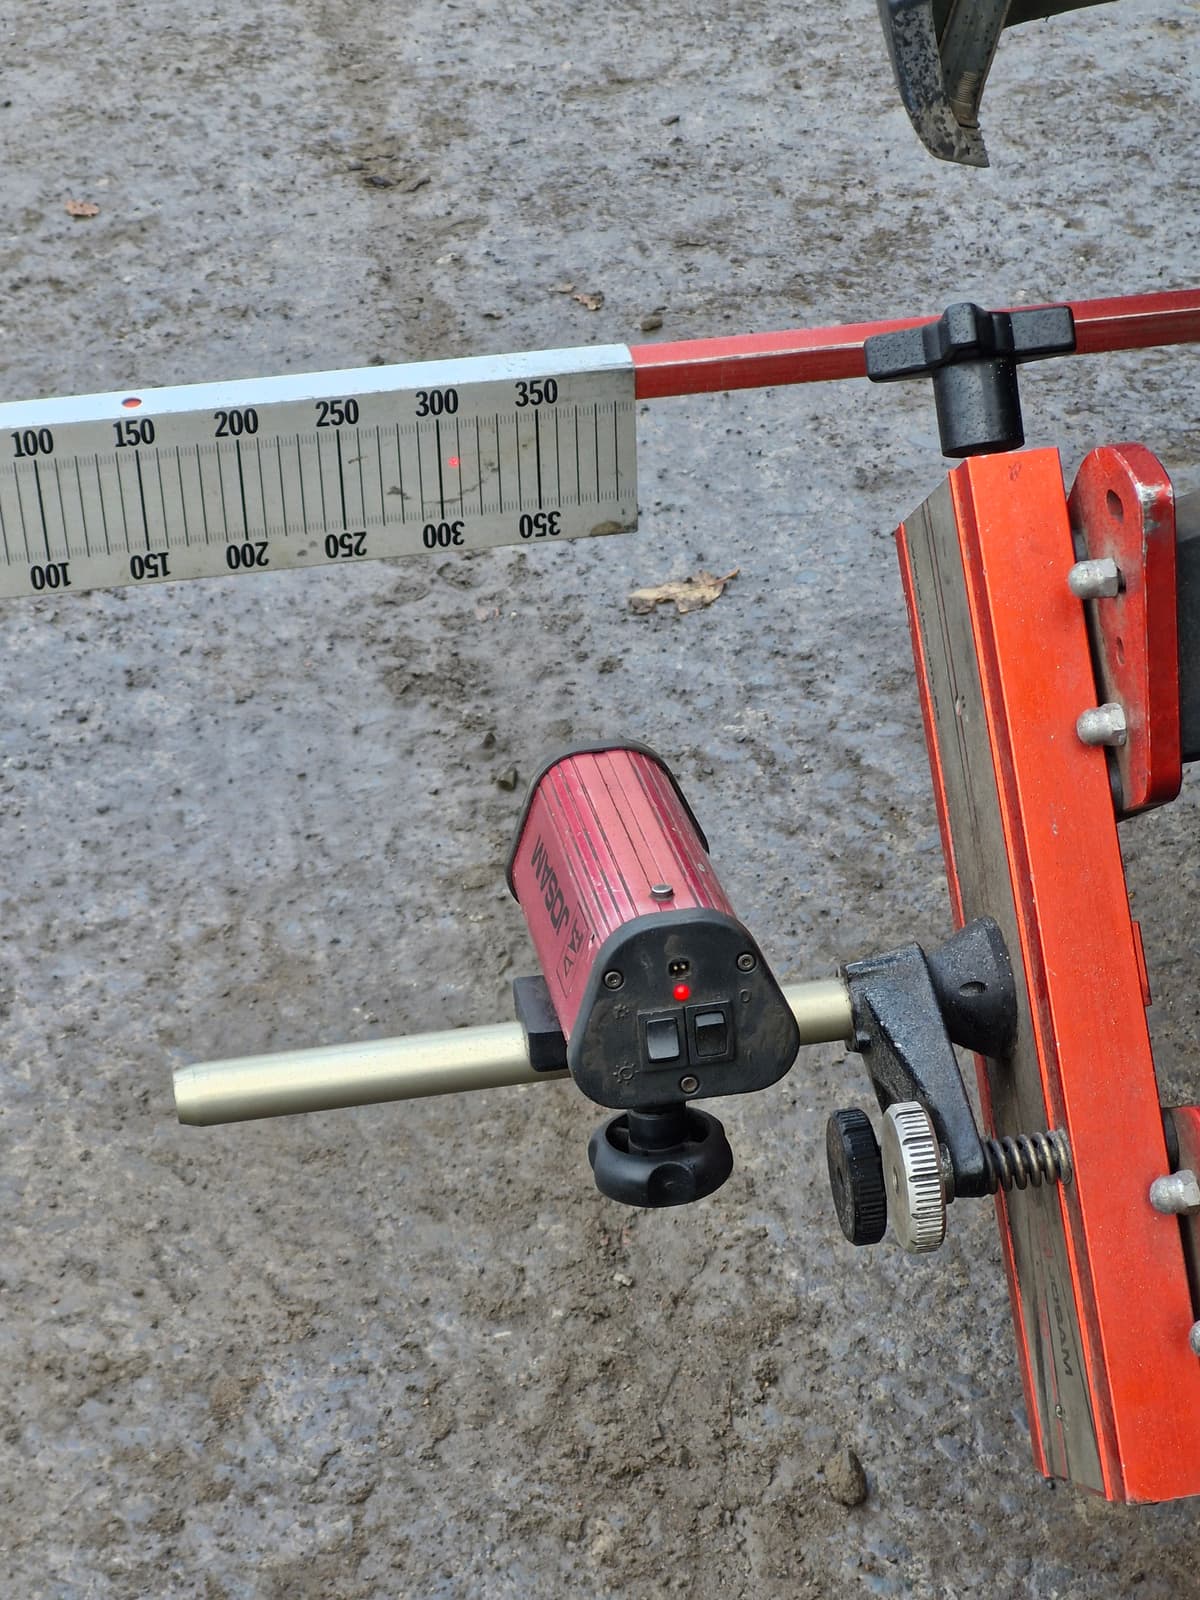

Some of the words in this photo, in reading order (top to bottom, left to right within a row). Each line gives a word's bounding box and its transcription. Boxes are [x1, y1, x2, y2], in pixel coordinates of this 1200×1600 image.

[11, 428, 54, 457] 100
[113, 418, 155, 447] 150
[214, 408, 259, 437] 200
[315, 399, 360, 427] 250
[415, 388, 459, 417] 300
[515, 378, 559, 407] 350
[422, 521, 466, 549] 300
[519, 510, 562, 538] 350
[226, 541, 269, 570] 200
[324, 531, 368, 559] 250
[30, 562, 72, 590] 100
[130, 552, 171, 580] 150
[531, 834, 570, 936] JOSAM
